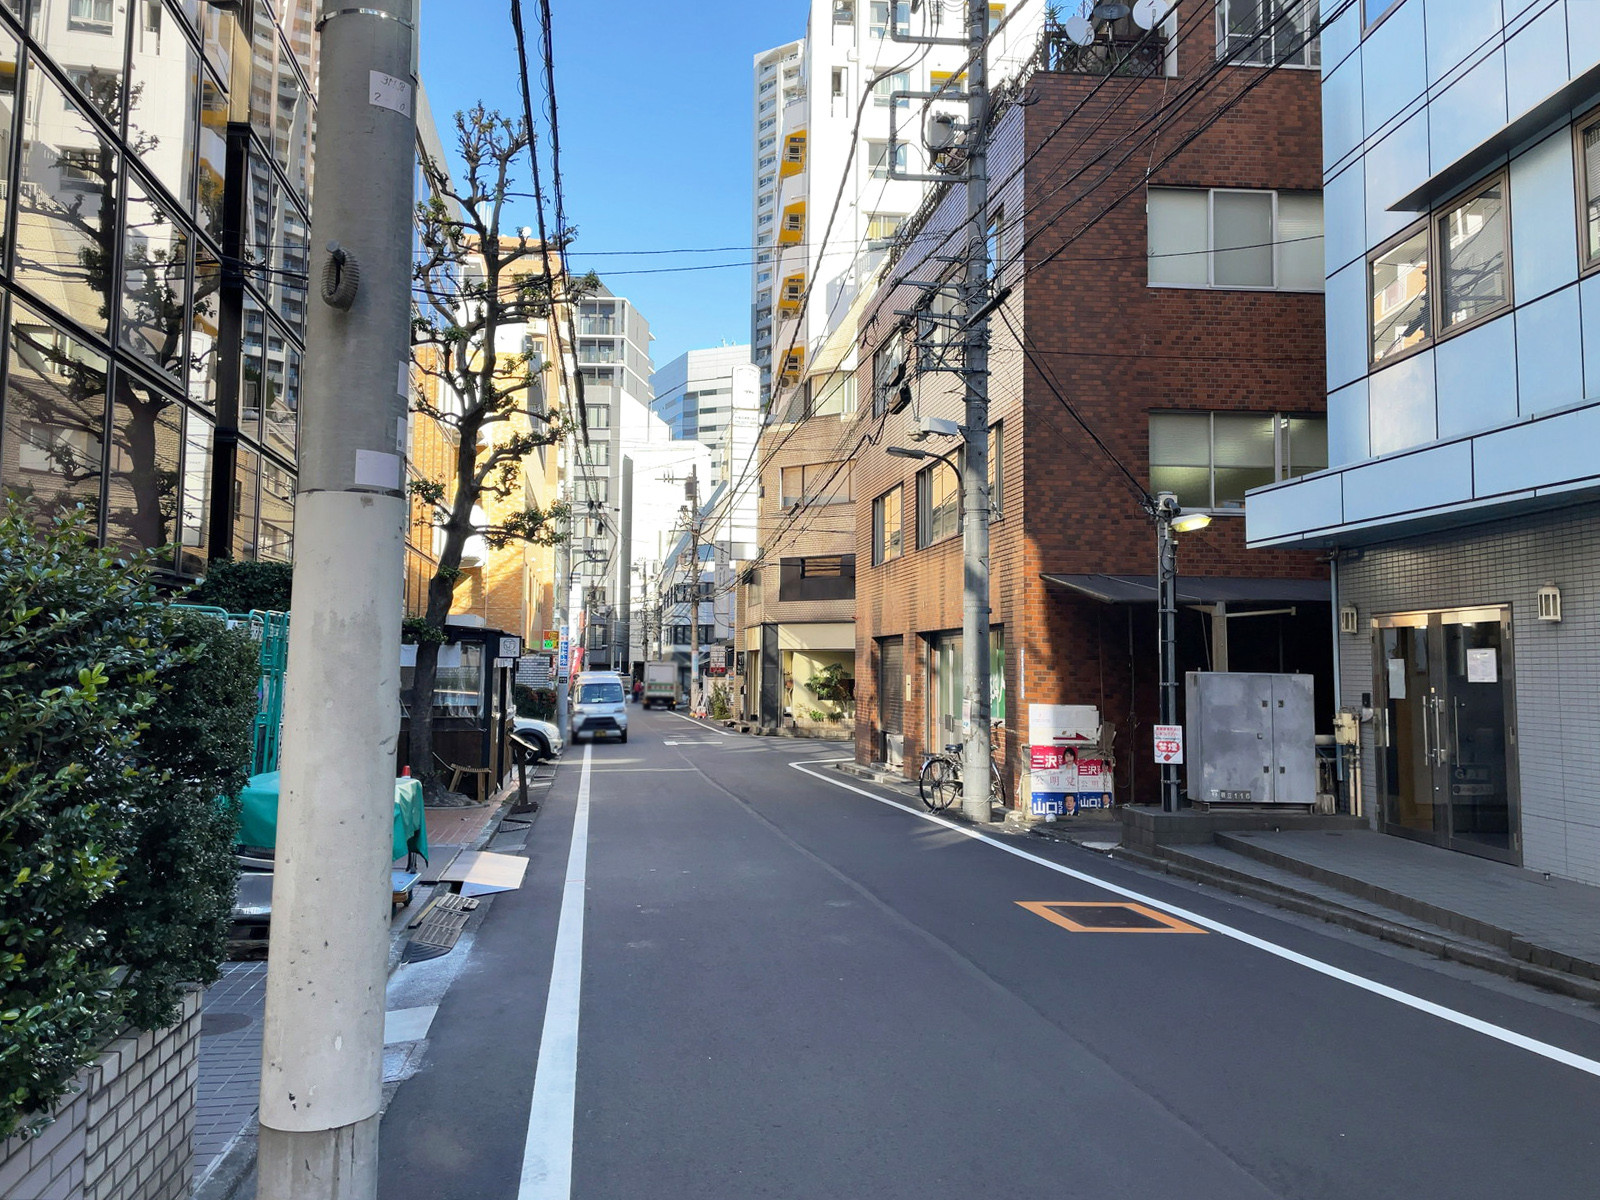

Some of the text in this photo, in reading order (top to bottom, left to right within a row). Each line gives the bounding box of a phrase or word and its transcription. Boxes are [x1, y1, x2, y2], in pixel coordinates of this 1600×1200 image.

[1032, 755, 1057, 768] 三沢
[1079, 765, 1097, 775] 三沢
[1034, 776, 1076, 787] 公明党
[1033, 801, 1057, 814] 山口
[1080, 798, 1097, 808] 山口
